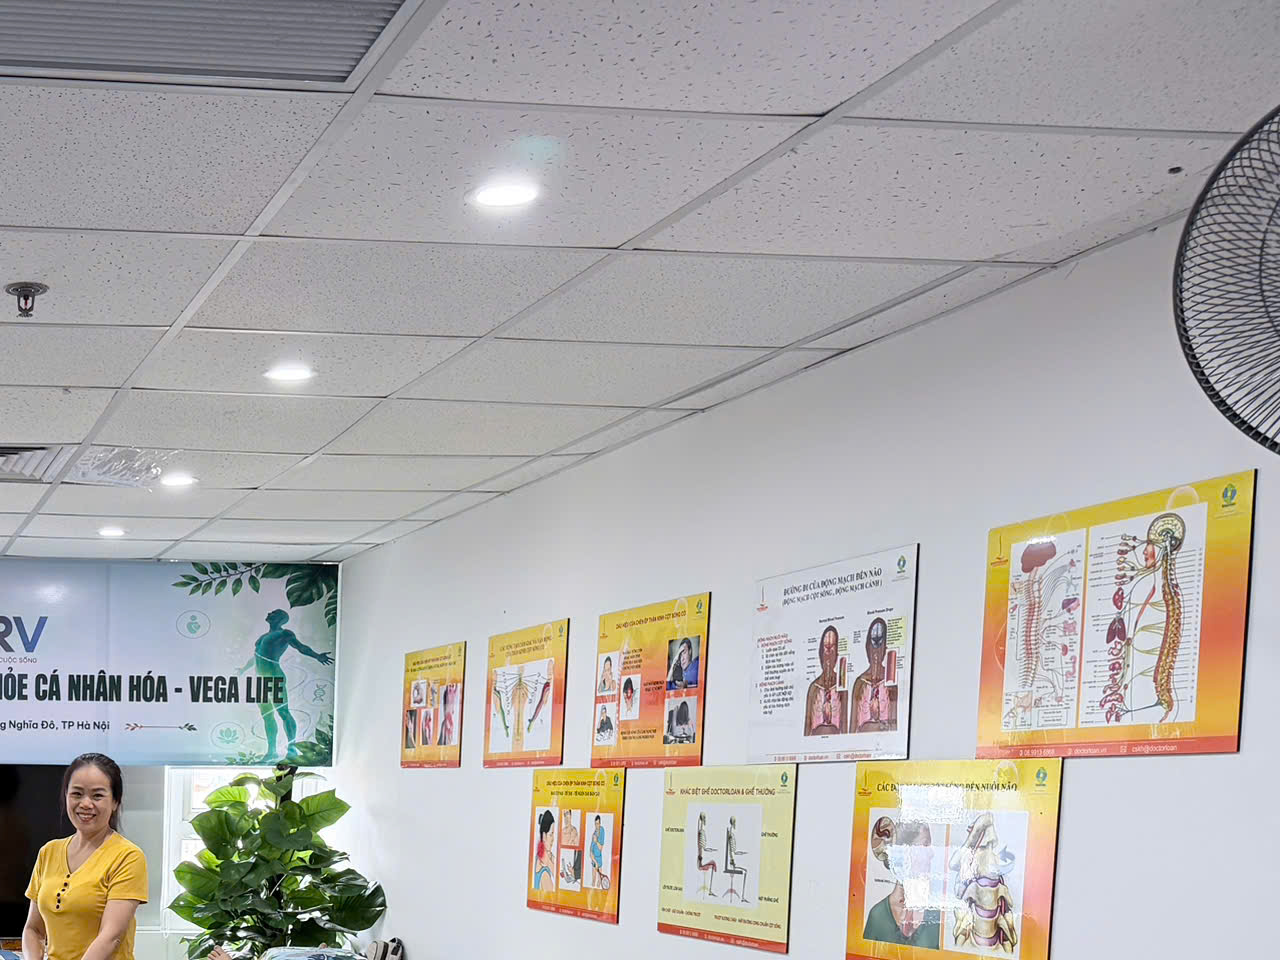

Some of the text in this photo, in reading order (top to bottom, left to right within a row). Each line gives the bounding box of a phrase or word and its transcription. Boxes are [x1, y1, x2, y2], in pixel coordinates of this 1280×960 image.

[34, 668, 61, 702] CÁ
[67, 669, 122, 703] NHÂN
[128, 670, 168, 703] HÓA
[189, 675, 240, 704] VEGA
[245, 675, 285, 704] LIFE
[8, 720, 39, 731] Nghĩa
[40, 719, 59, 731] Đô,
[61, 720, 75, 730] TP
[77, 720, 91, 730] Hà
[93, 720, 110, 732] Nội
